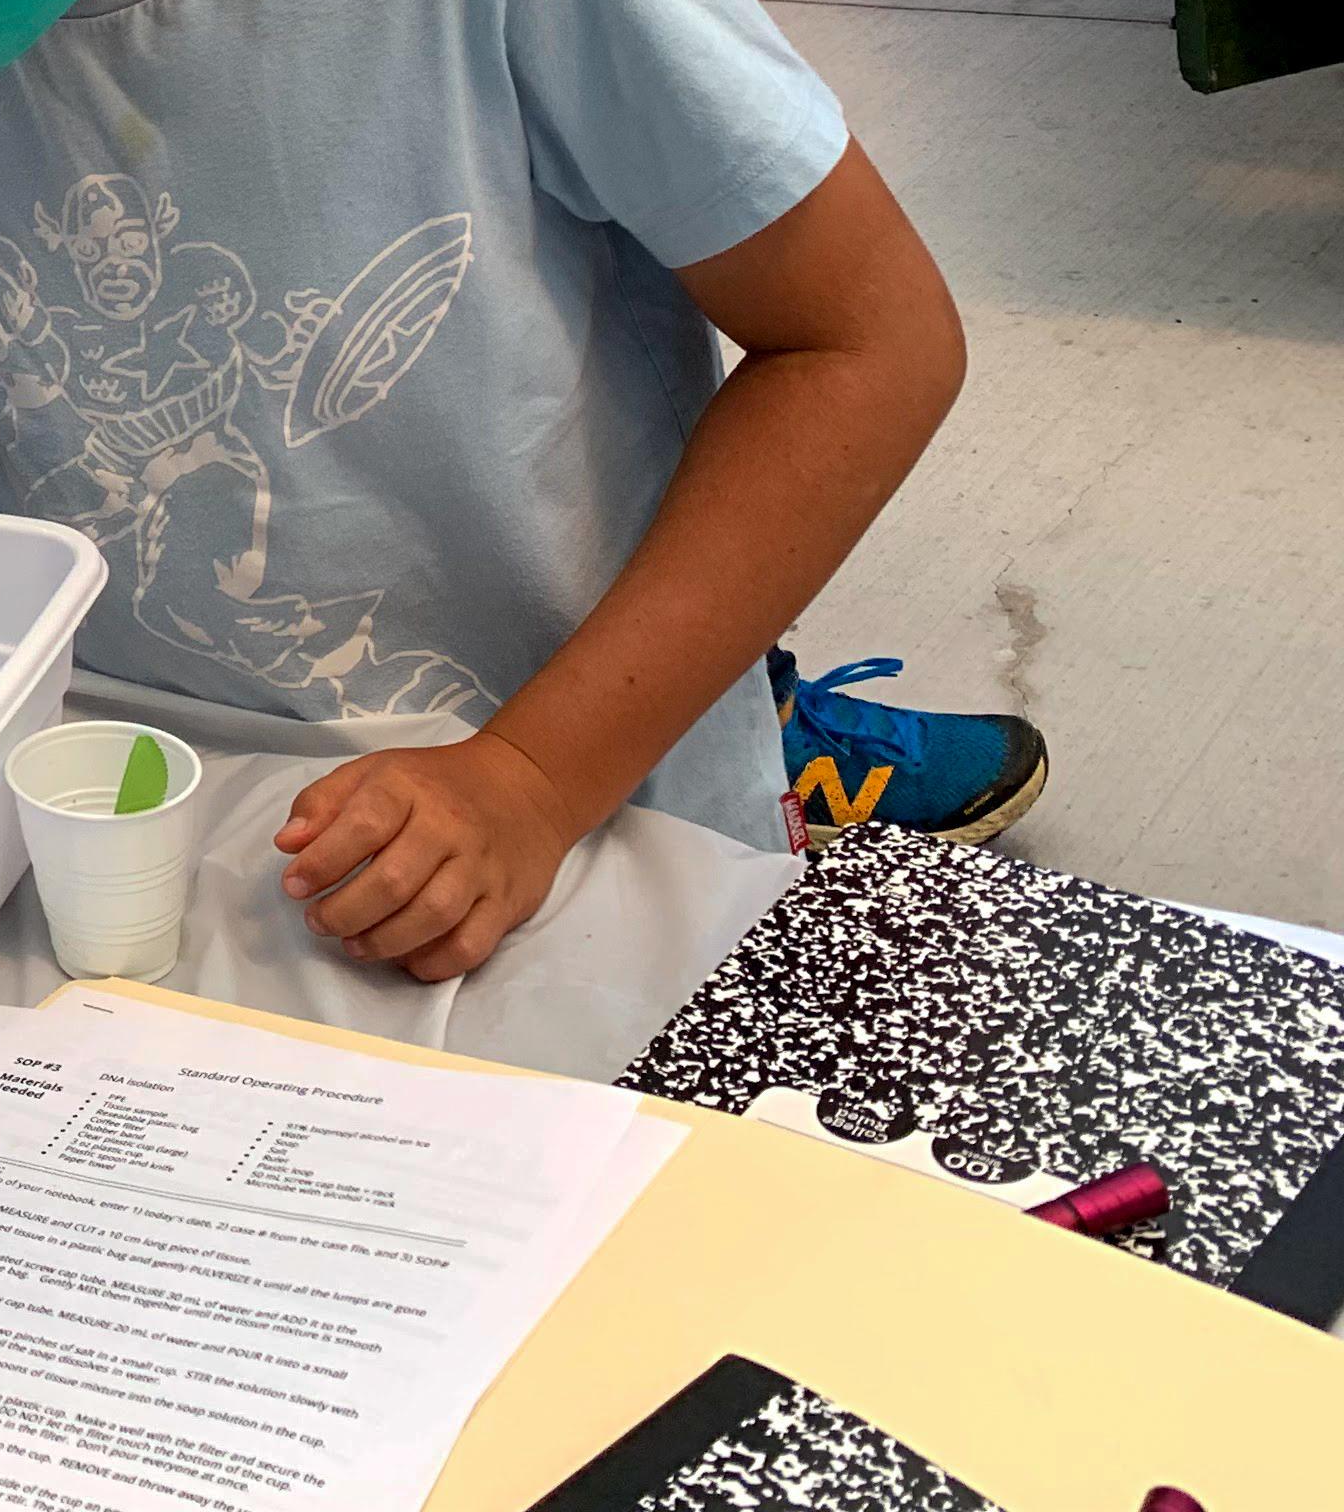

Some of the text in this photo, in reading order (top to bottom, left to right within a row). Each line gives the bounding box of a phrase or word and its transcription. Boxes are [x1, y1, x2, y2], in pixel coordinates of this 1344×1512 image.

[14, 1057, 62, 1071] SOP #3
[0, 1073, 63, 1092] Materials
[99, 1073, 125, 1084] DNA
[179, 1067, 384, 1104] Standard Operating Procedure
[103, 1101, 169, 1119] Tissue sample
[89, 1116, 146, 1132] Coffee filter
[146, 1119, 179, 1130] plastic
[180, 1123, 200, 1134] bag
[822, 1115, 889, 1143] College
[836, 1108, 889, 1133] Ruled
[83, 1123, 146, 1141] Rubber band
[77, 1130, 189, 1158] Clear plastic cup (large)
[90, 1143, 124, 1155] plastic
[124, 1150, 144, 1159] cup
[58, 1153, 117, 1171] Paper towel
[96, 1153, 128, 1164] spoon
[127, 1158, 150, 1168] and
[262, 1154, 290, 1164] Ruler
[944, 1153, 1005, 1181] 100
[283, 1176, 314, 1186] screw
[314, 1181, 335, 1190] cap
[335, 1183, 361, 1194] tube
[49, 1219, 74, 1229] and
[73, 1223, 98, 1234] CUT
[97, 1229, 106, 1237] a
[109, 1230, 124, 1240] 10
[123, 1235, 142, 1244] cm
[141, 1238, 168, 1251] long
[167, 1244, 200, 1256] piece
[200, 1249, 217, 1258] of
[29, 1369, 46, 1378] of
[44, 1372, 79, 1387] tissue
[79, 1381, 126, 1399] mixture
[127, 1391, 152, 1404] into
[153, 1397, 175, 1409] the
[174, 1403, 206, 1417] soap
[207, 1410, 258, 1429] solution
[259, 1422, 274, 1433] in
[275, 1426, 297, 1440] the
[22, 1484, 39, 1495] of
[37, 1488, 59, 1501] the
[60, 1495, 83, 1509] cup
